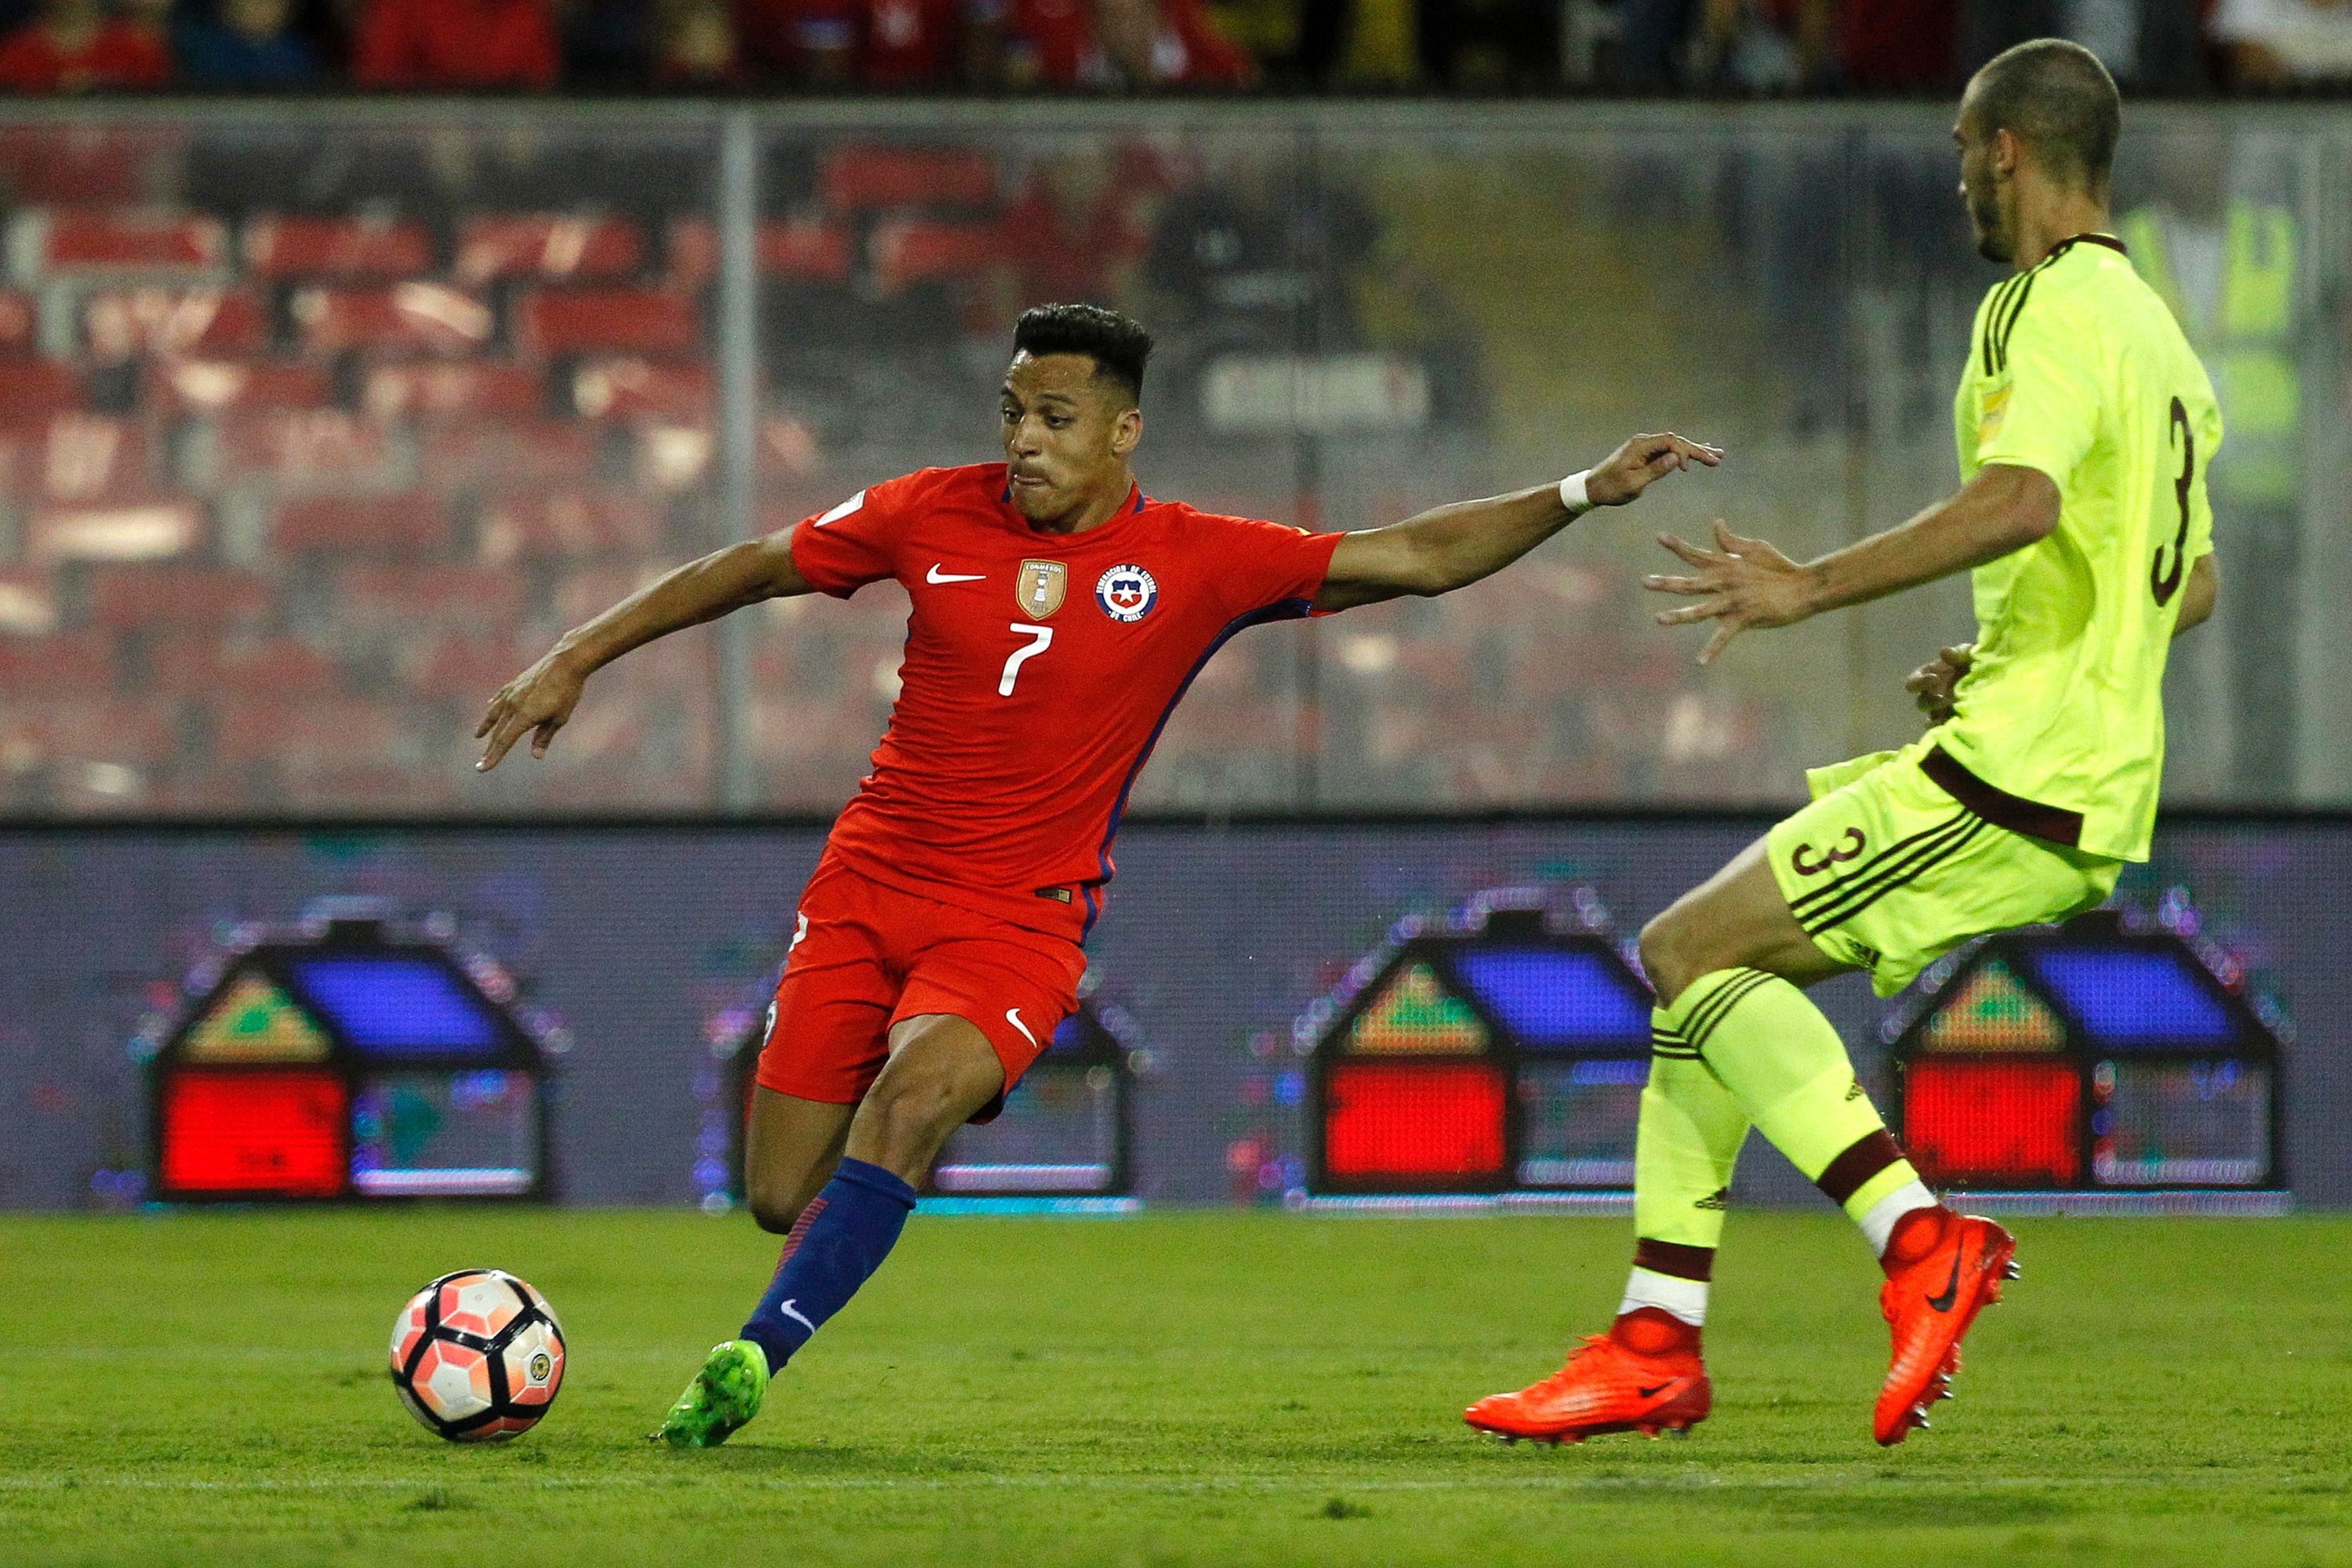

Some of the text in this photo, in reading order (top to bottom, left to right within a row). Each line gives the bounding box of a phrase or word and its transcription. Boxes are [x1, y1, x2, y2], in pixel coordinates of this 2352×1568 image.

[2151, 395, 2194, 608] 3
[1141, 570, 1156, 593] FUTBOL
[1109, 611, 1142, 622] DE CHILE
[998, 622, 1054, 697] 7
[1792, 827, 1866, 876] 3
